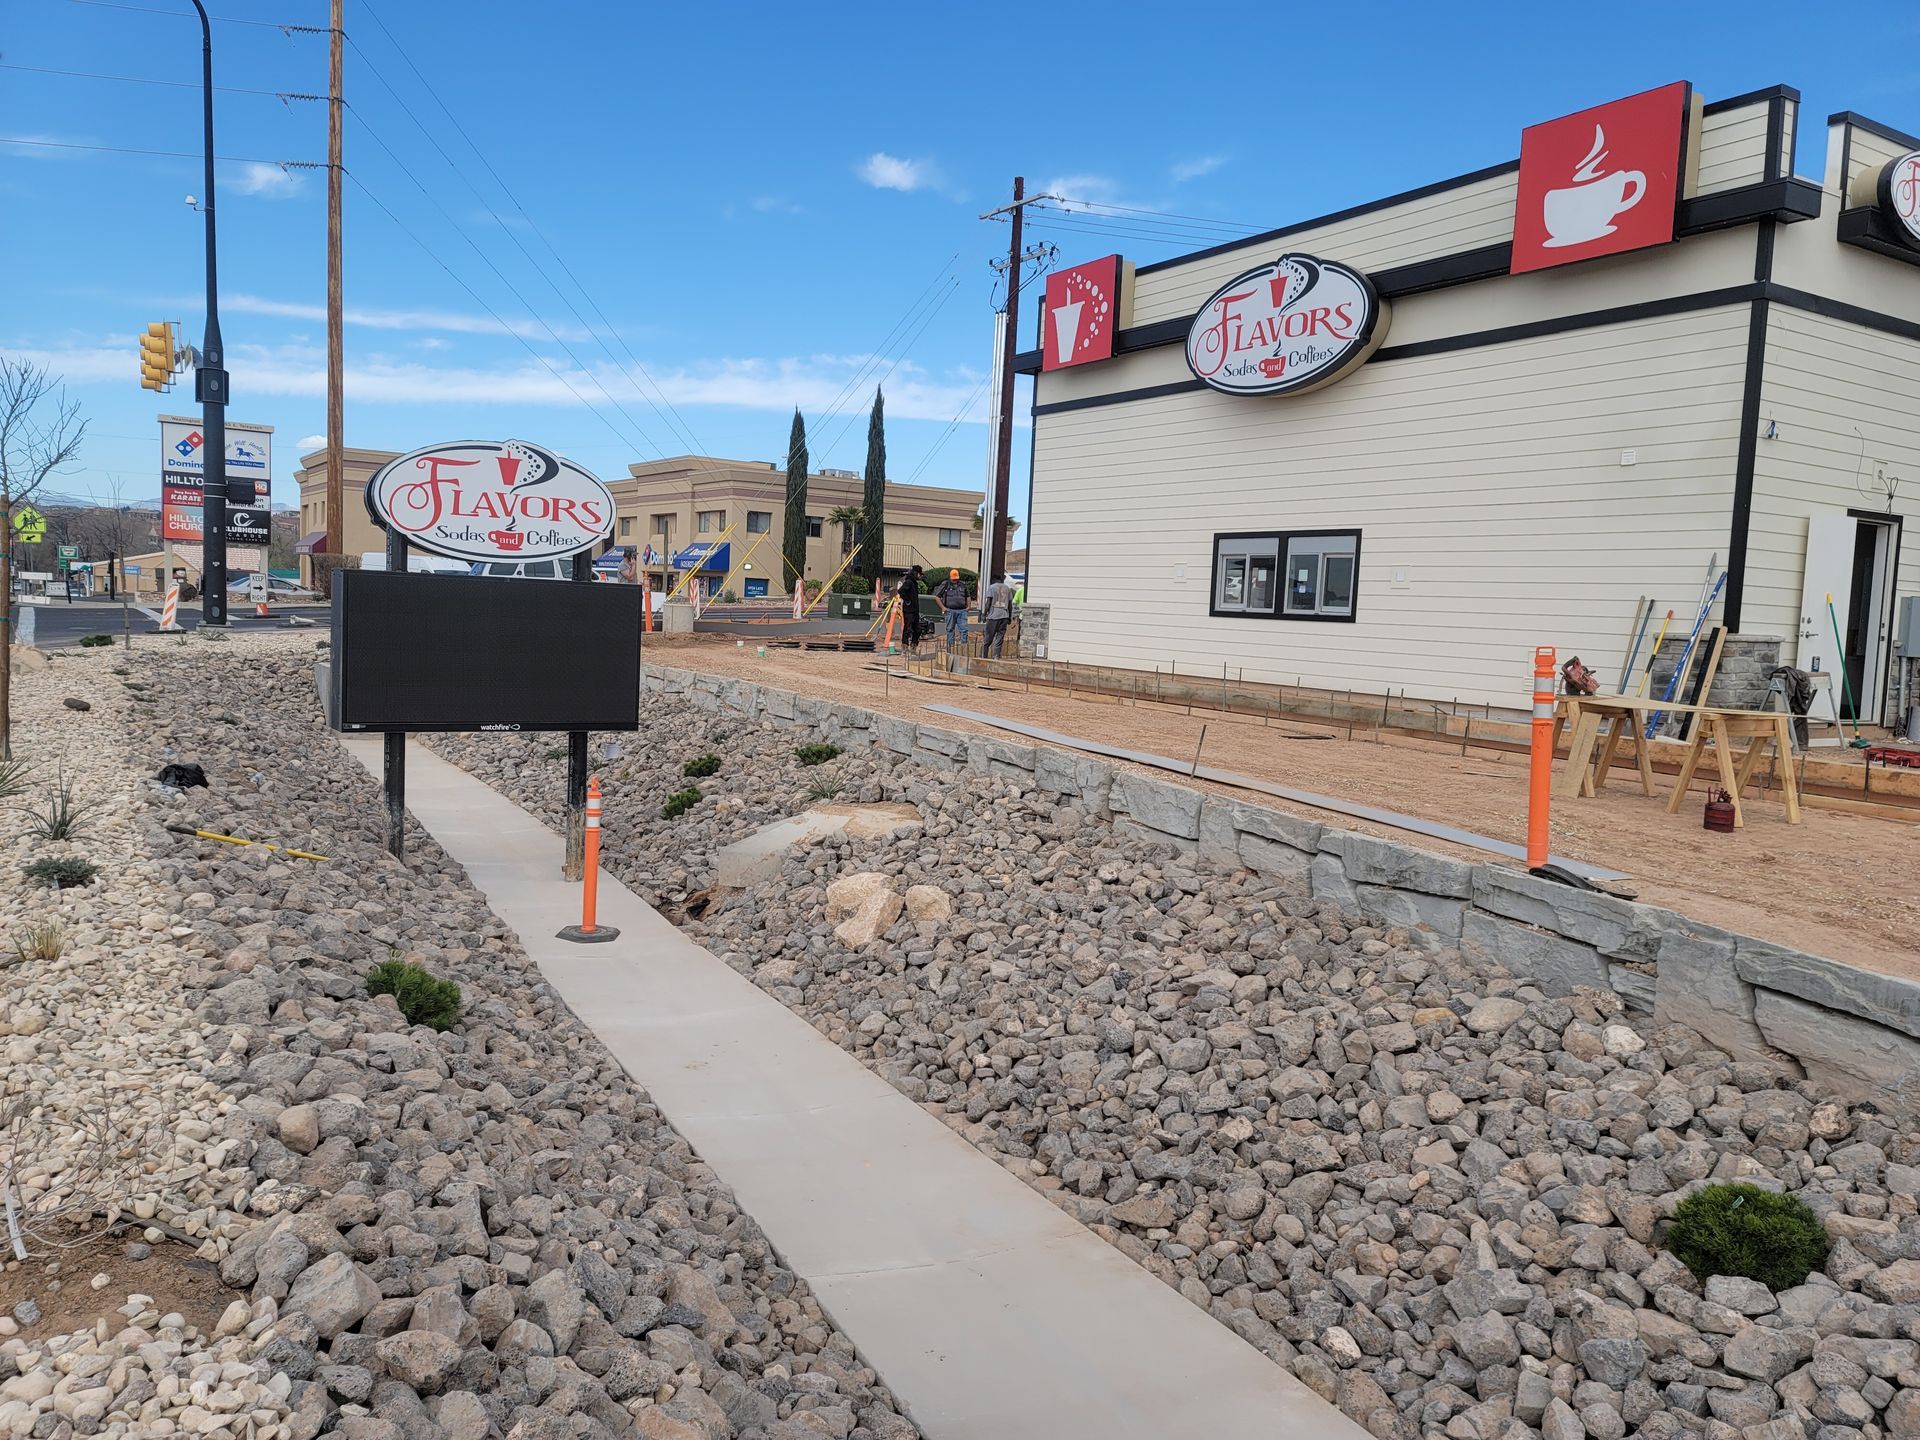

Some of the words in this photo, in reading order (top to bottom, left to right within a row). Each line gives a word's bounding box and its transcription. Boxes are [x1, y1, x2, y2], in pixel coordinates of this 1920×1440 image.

[1194, 288, 1356, 376] FLAVORS
[1222, 358, 1258, 378] Sodas
[1266, 361, 1281, 372] and
[1288, 345, 1334, 367] Coffees
[168, 458, 204, 469] Domino
[165, 475, 204, 486] HILLTO
[170, 494, 201, 502] KARATE
[389, 456, 606, 534] FLAVORS
[169, 513, 204, 523] HILLTO
[169, 521, 204, 531] CHURC
[435, 525, 486, 543] Sodas
[499, 532, 519, 545] and
[526, 529, 581, 546] Coffees
[480, 723, 510, 731] watchfire
